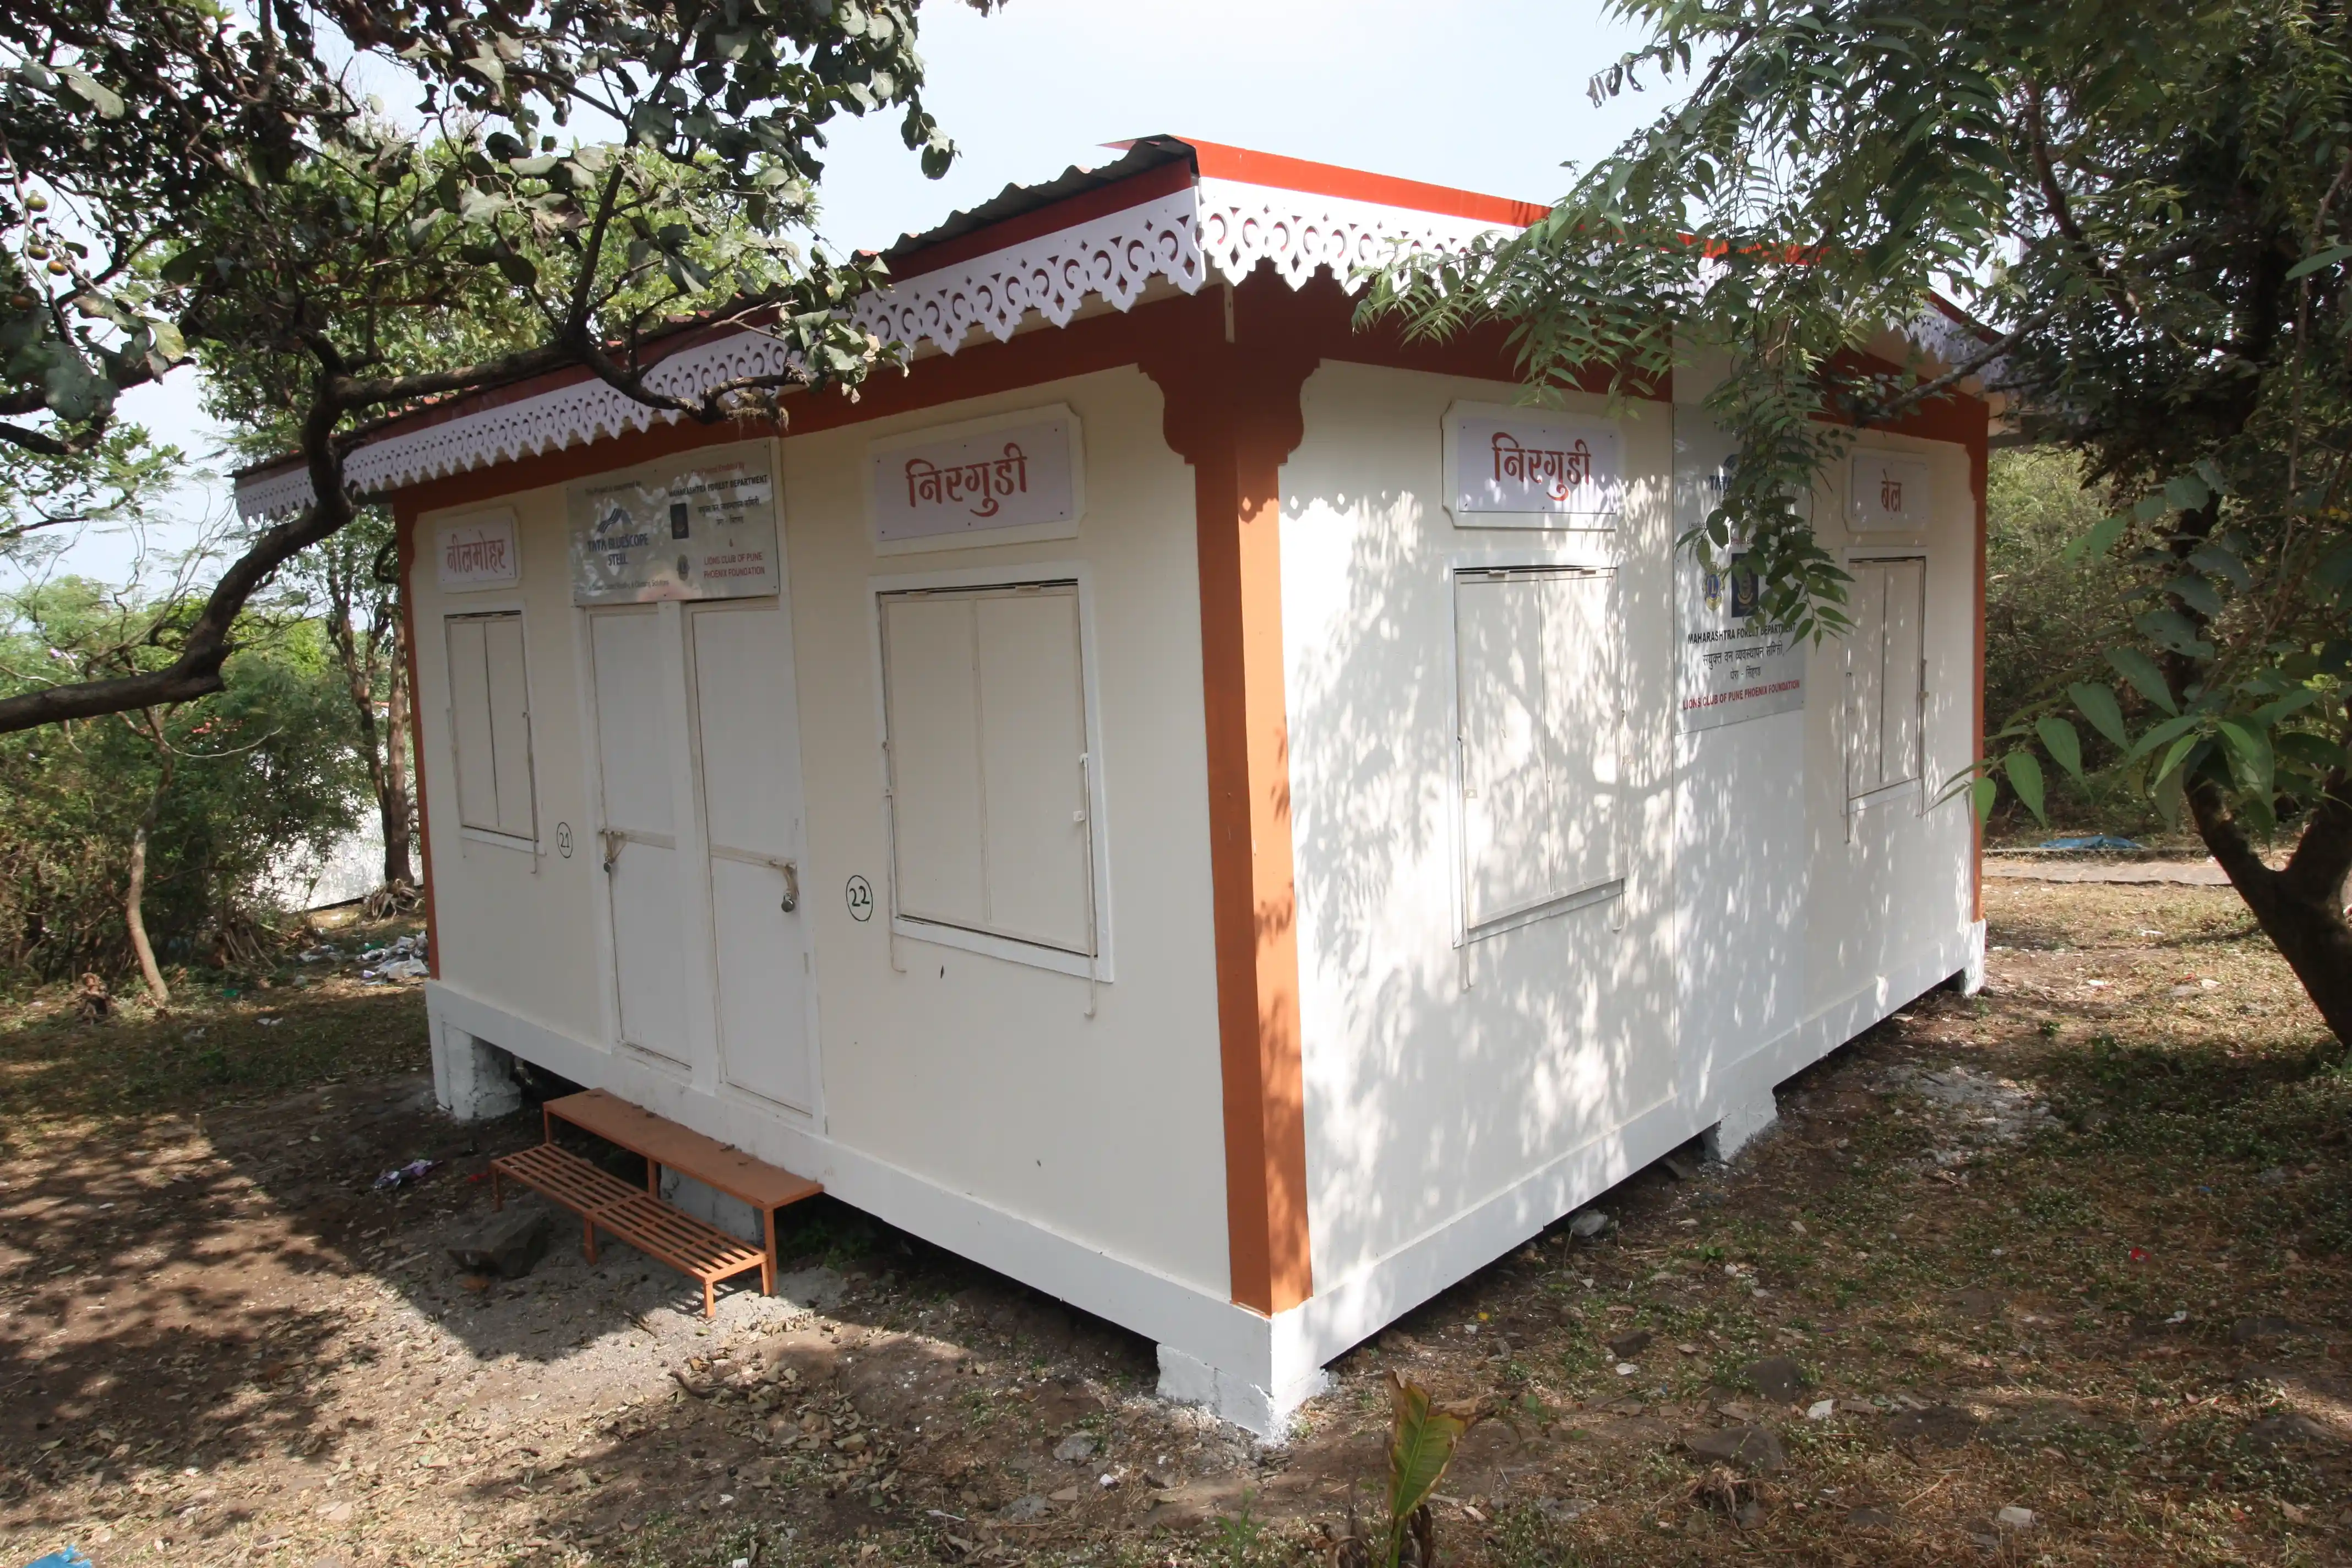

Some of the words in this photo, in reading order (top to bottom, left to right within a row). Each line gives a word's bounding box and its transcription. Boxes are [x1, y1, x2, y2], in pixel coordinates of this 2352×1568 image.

[1491, 432, 1591, 501] निरगुडी
[730, 475, 768, 488] DEPARTMENT
[905, 442, 1027, 518] निरगुडी
[1881, 469, 1902, 513] बेल
[447, 530, 506, 573] नीलमोहर
[587, 538, 607, 553] TATA
[608, 533, 649, 549] BLUESCOPE
[608, 553, 628, 566] STEEL
[704, 556, 720, 565] LIONS
[721, 554, 736, 564] CLUB
[738, 553, 745, 562] OF
[747, 552, 763, 561] PUNE
[704, 569, 727, 579] PHOENIX
[728, 567, 765, 577] FOUNDATION
[1687, 629, 1735, 644] MAHARASHTRA
[1736, 626, 1759, 638] FORET
[1760, 623, 1796, 636] DEPARTNT
[1702, 650, 1722, 669] संयुक्त
[1724, 651, 1733, 662] वन
[1735, 646, 1764, 661] व्यवस्थापन
[1683, 698, 1701, 710] LIONS
[1702, 694, 1718, 707] CLUB
[1719, 693, 1727, 703] OF
[1728, 690, 1743, 701] PUNE
[1744, 685, 1767, 699] PHOENIX
[1768, 679, 1800, 693] FOUNDATION
[559, 832, 570, 848] 21
[849, 885, 870, 907] 22
